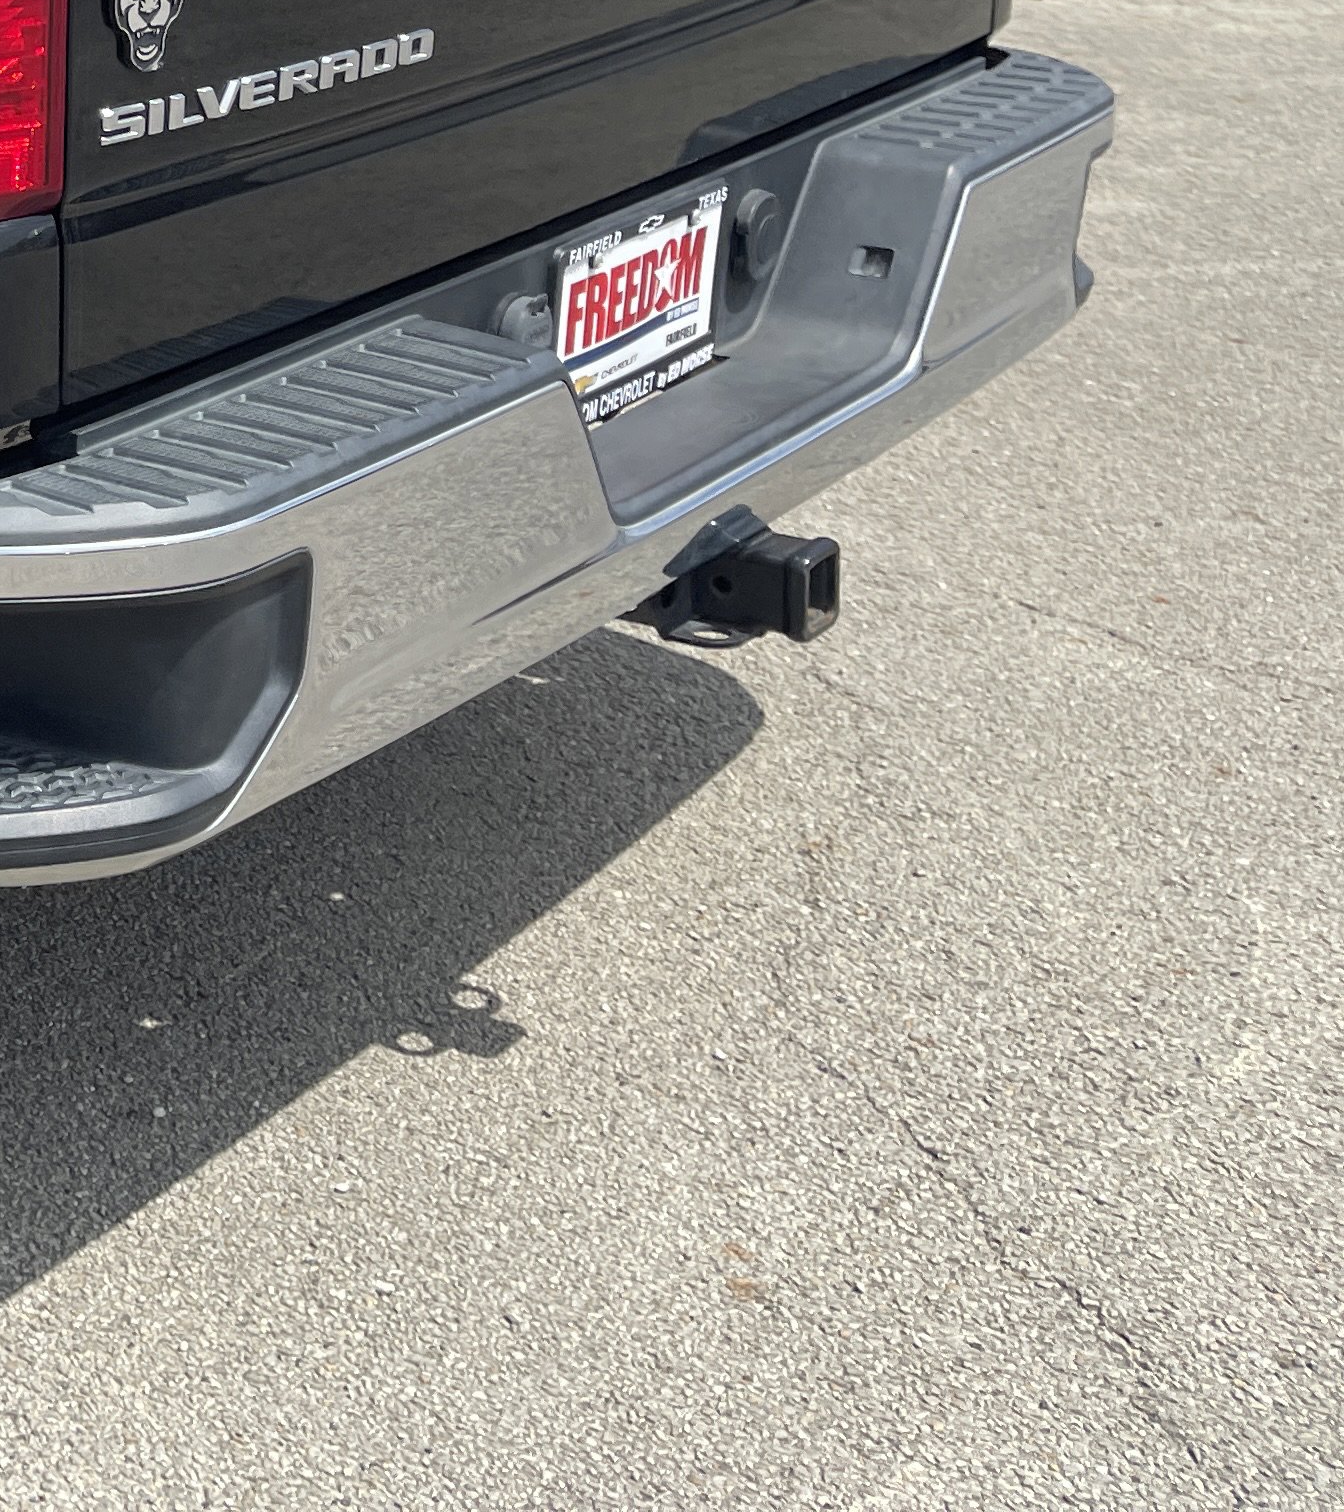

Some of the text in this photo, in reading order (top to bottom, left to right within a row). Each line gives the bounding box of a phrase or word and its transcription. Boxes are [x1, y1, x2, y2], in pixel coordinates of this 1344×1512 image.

[100, 28, 435, 146] SILVERADO
[568, 186, 729, 266] FAIRFIELD TEXAS
[564, 225, 709, 357] FREEDOM
[599, 370, 656, 417] CHEVROLET
